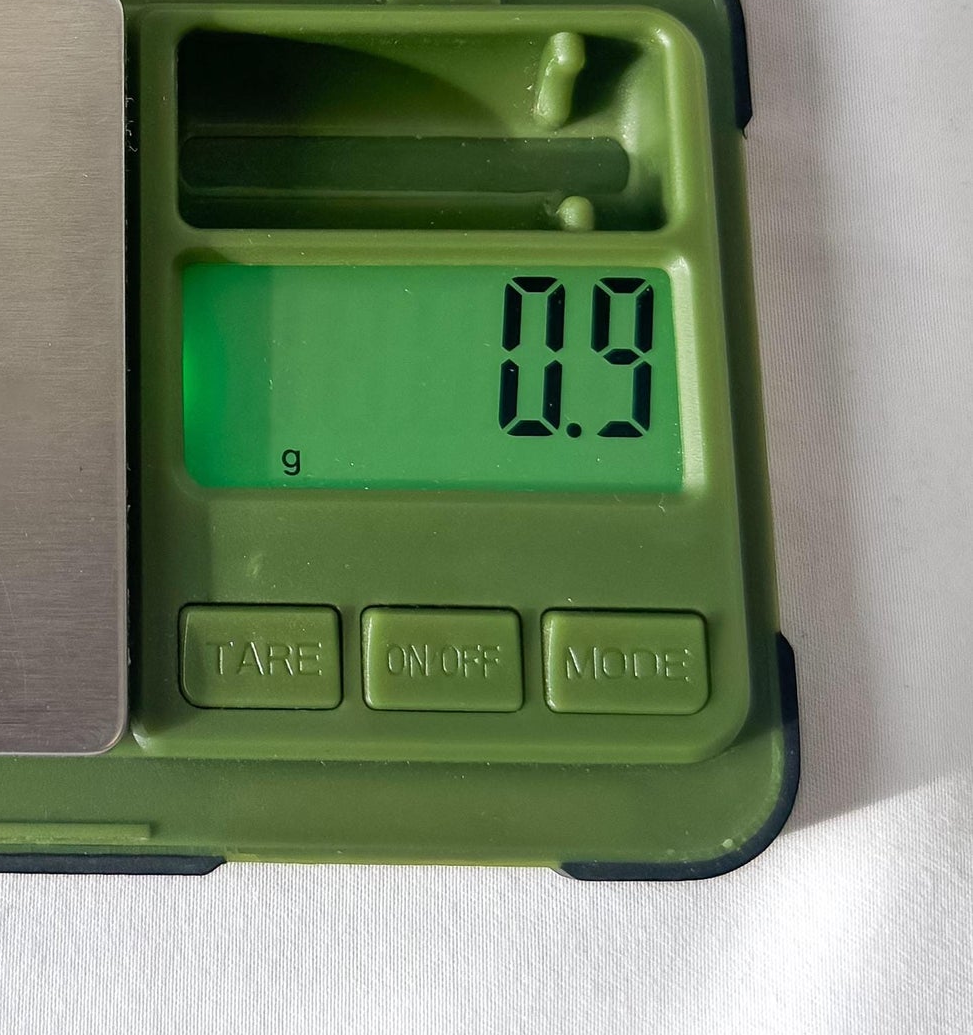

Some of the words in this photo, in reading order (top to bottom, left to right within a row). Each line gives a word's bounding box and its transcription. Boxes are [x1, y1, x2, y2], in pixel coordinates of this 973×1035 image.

[499, 276, 654, 438] 0.9
[282, 447, 301, 476] g
[207, 640, 323, 676] TARE
[566, 645, 693, 683] MODE
